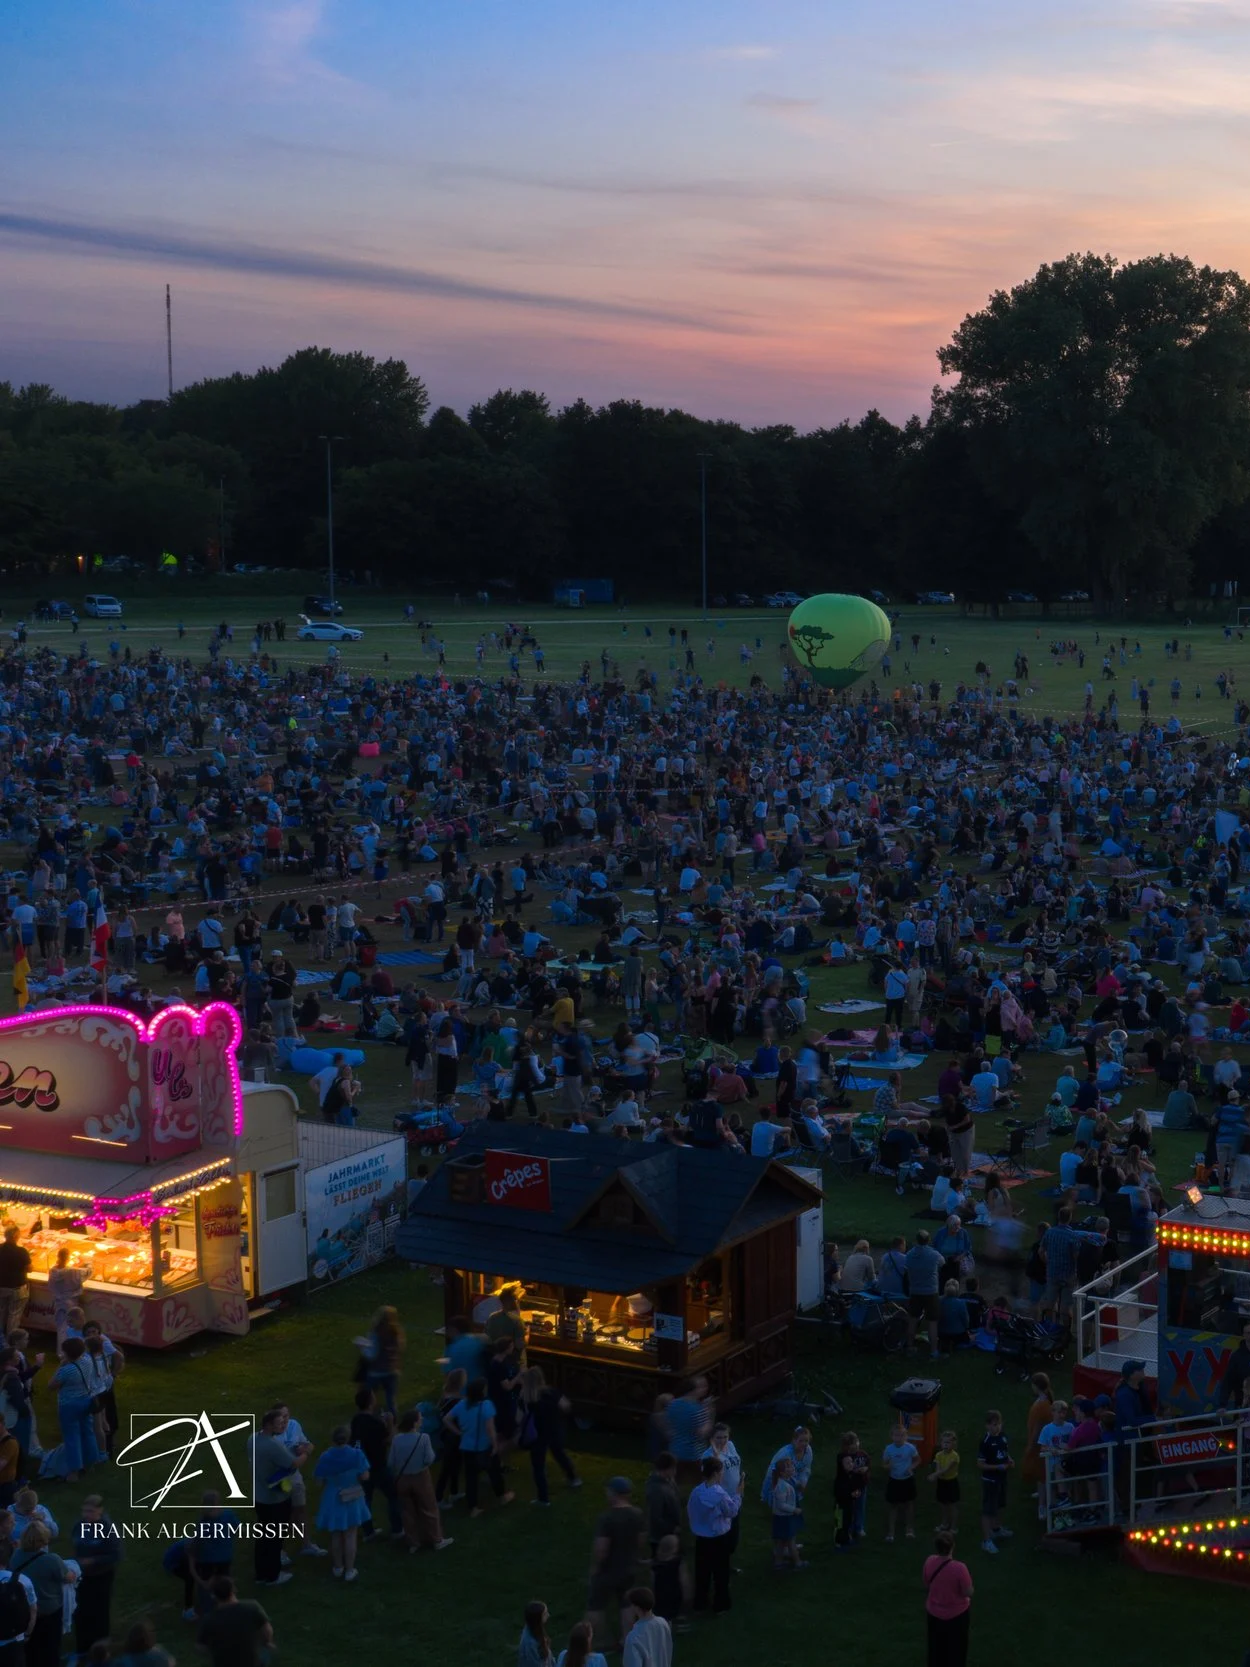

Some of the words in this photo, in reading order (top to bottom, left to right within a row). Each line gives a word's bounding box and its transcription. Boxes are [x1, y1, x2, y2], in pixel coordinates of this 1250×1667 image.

[325, 1182, 347, 1196] LÄSST
[348, 1174, 371, 1188] DEINE
[372, 1165, 390, 1179] WELT
[328, 1154, 386, 1183] JAHRMARKT
[491, 1162, 542, 1200] Crêpes
[333, 1179, 382, 1207] FLIEGEN
[1161, 1436, 1218, 1459] EINGANG
